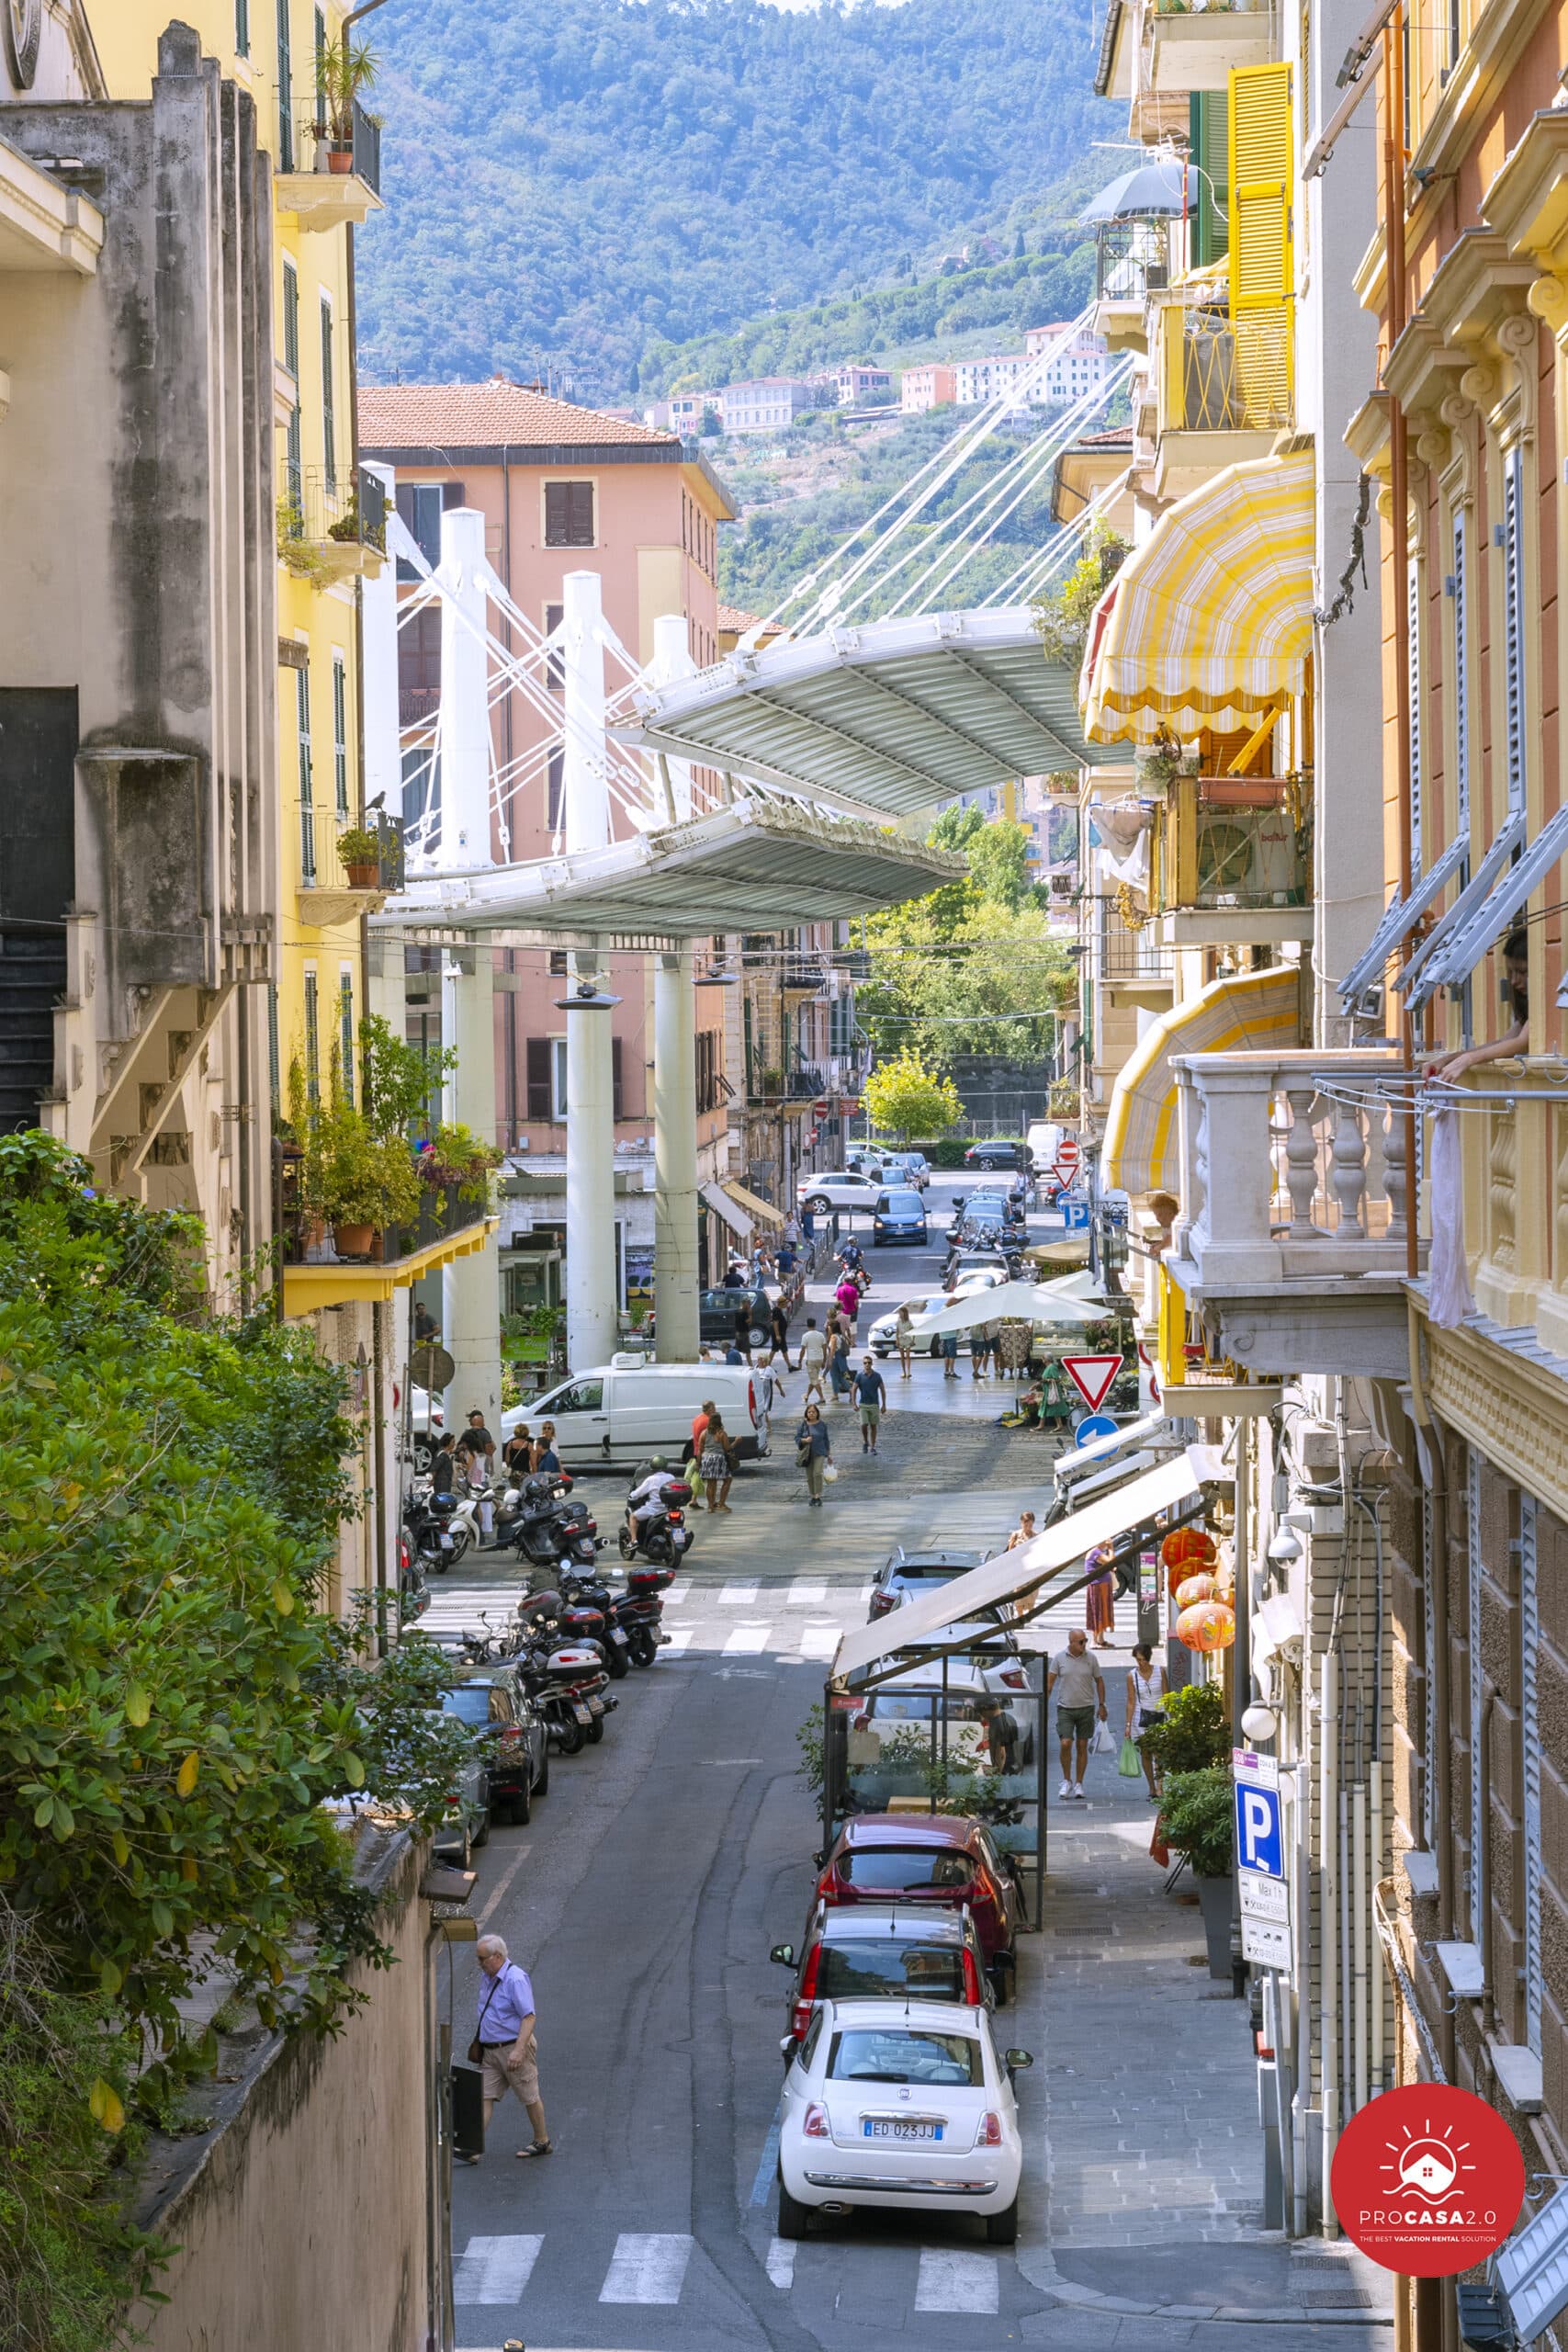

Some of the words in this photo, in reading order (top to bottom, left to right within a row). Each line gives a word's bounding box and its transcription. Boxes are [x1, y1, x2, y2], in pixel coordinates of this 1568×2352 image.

[1069, 1205, 1085, 1228] P
[1244, 1791, 1272, 1861] P
[1258, 1881, 1271, 1896] Max
[874, 2123, 888, 2135] ED
[894, 2124, 934, 2138] 023JJ
